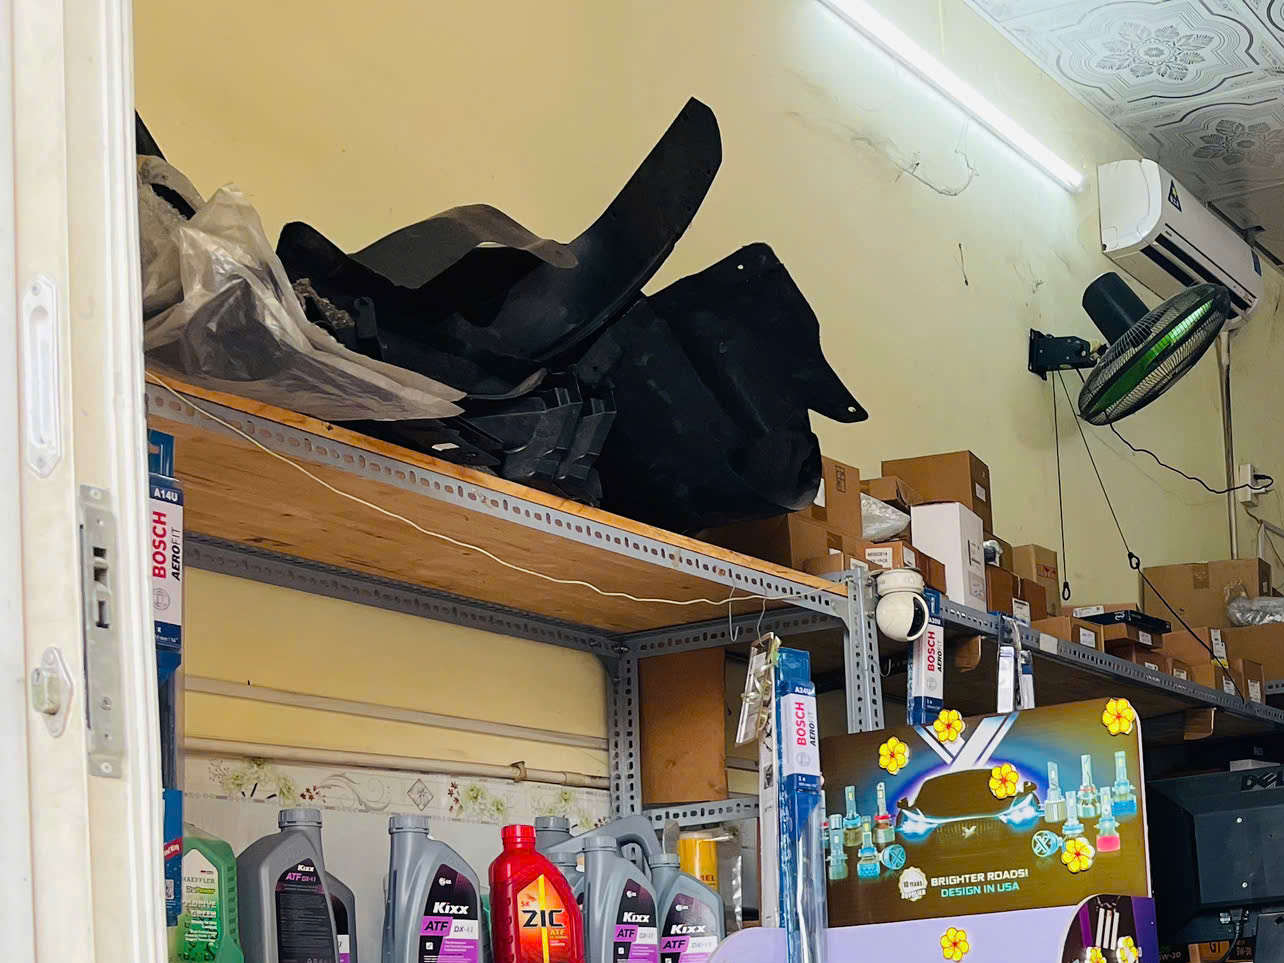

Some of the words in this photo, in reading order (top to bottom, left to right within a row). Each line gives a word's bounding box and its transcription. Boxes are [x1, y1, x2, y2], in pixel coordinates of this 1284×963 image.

[153, 487, 178, 502] A14U
[152, 510, 167, 580] BOSCH
[171, 527, 182, 582] AEROFIT
[927, 631, 936, 672] BOSCH
[794, 701, 807, 746] BOSCH
[297, 864, 315, 872] Kixx
[286, 872, 301, 881] ATF
[930, 872, 985, 887] BRIGHTER
[987, 868, 1029, 881] ROADS!
[941, 885, 981, 898] DESIGN
[984, 883, 995, 893] IN
[997, 881, 1020, 892] USA
[433, 902, 469, 915] Kixx
[522, 909, 565, 929] ZIC
[622, 912, 650, 923] Kixx
[424, 921, 449, 931] ATF
[670, 924, 706, 935] Kixx
[617, 929, 635, 938] ATF
[663, 940, 686, 949] ATF
[1159, 951, 1182, 961] W-30
